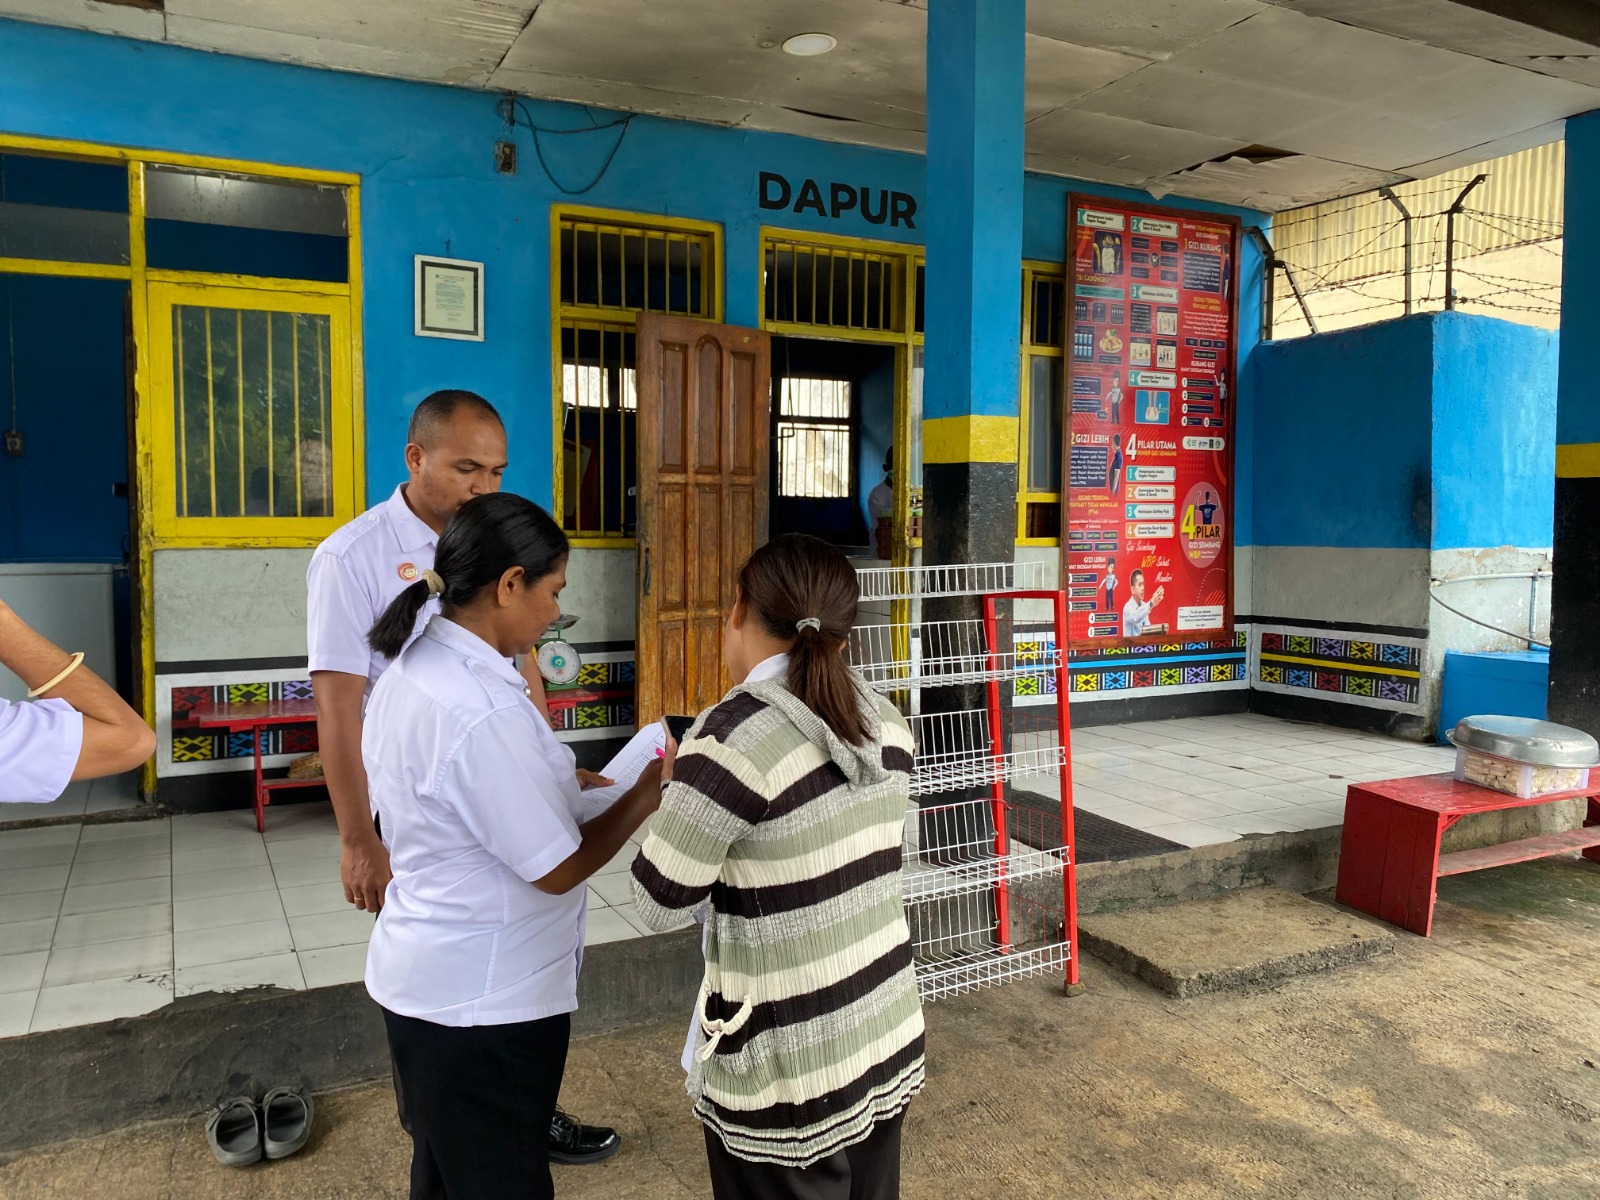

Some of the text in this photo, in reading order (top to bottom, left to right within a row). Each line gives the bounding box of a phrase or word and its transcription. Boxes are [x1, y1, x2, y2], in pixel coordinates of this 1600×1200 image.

[759, 171, 917, 229] DAPUR
[1132, 220, 1138, 230] 2
[1188, 241, 1200, 249] GIZI
[1200, 243, 1221, 252] KURANG
[1133, 286, 1137, 297] 3
[1131, 373, 1135, 384] 4
[1076, 434, 1090, 443] GIZI
[1092, 434, 1109, 443] LEBIH
[1126, 434, 1176, 460] 4 PILAR UTAMA
[1129, 468, 1132, 479] 1
[1128, 487, 1133, 497] 2
[1128, 506, 1132, 517] 3
[1181, 504, 1220, 540] 4 PILAR
[1128, 526, 1132, 536] 4
[1126, 540, 1156, 554] Gizi Seimbang
[1141, 556, 1156, 568] WBP
